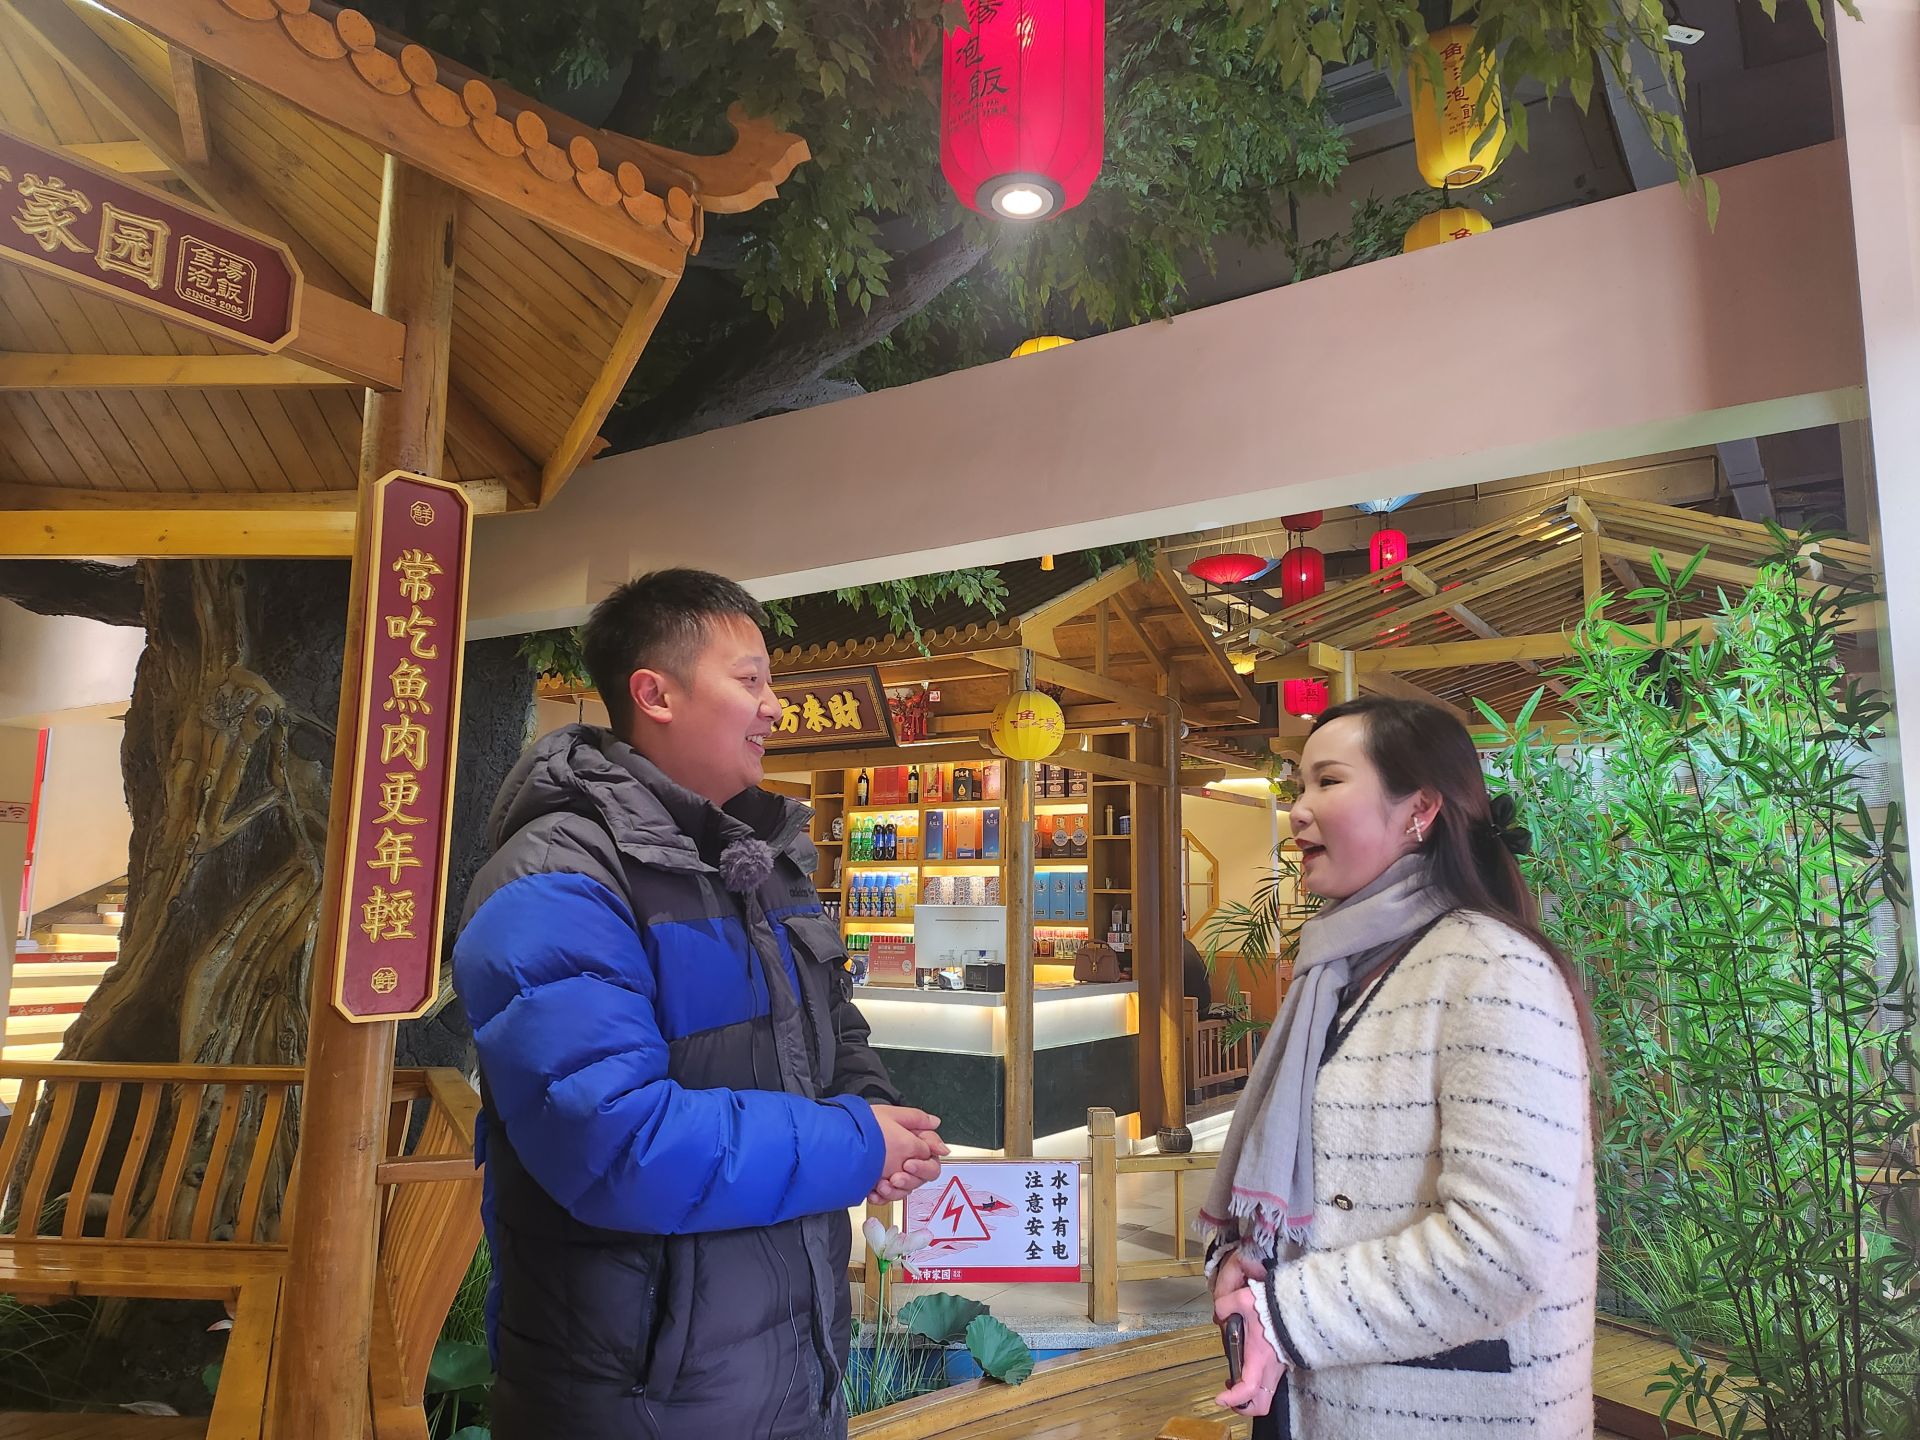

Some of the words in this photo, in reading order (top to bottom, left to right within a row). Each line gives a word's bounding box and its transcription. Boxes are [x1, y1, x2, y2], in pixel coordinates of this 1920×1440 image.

[0, 165, 171, 290] 家园
[184, 287, 217, 305] SINCE
[360, 548, 444, 944] 常吃魚肉更年輕
[1024, 1170, 1044, 1260] 注意安全
[1050, 1170, 1070, 1260] 水中有电
